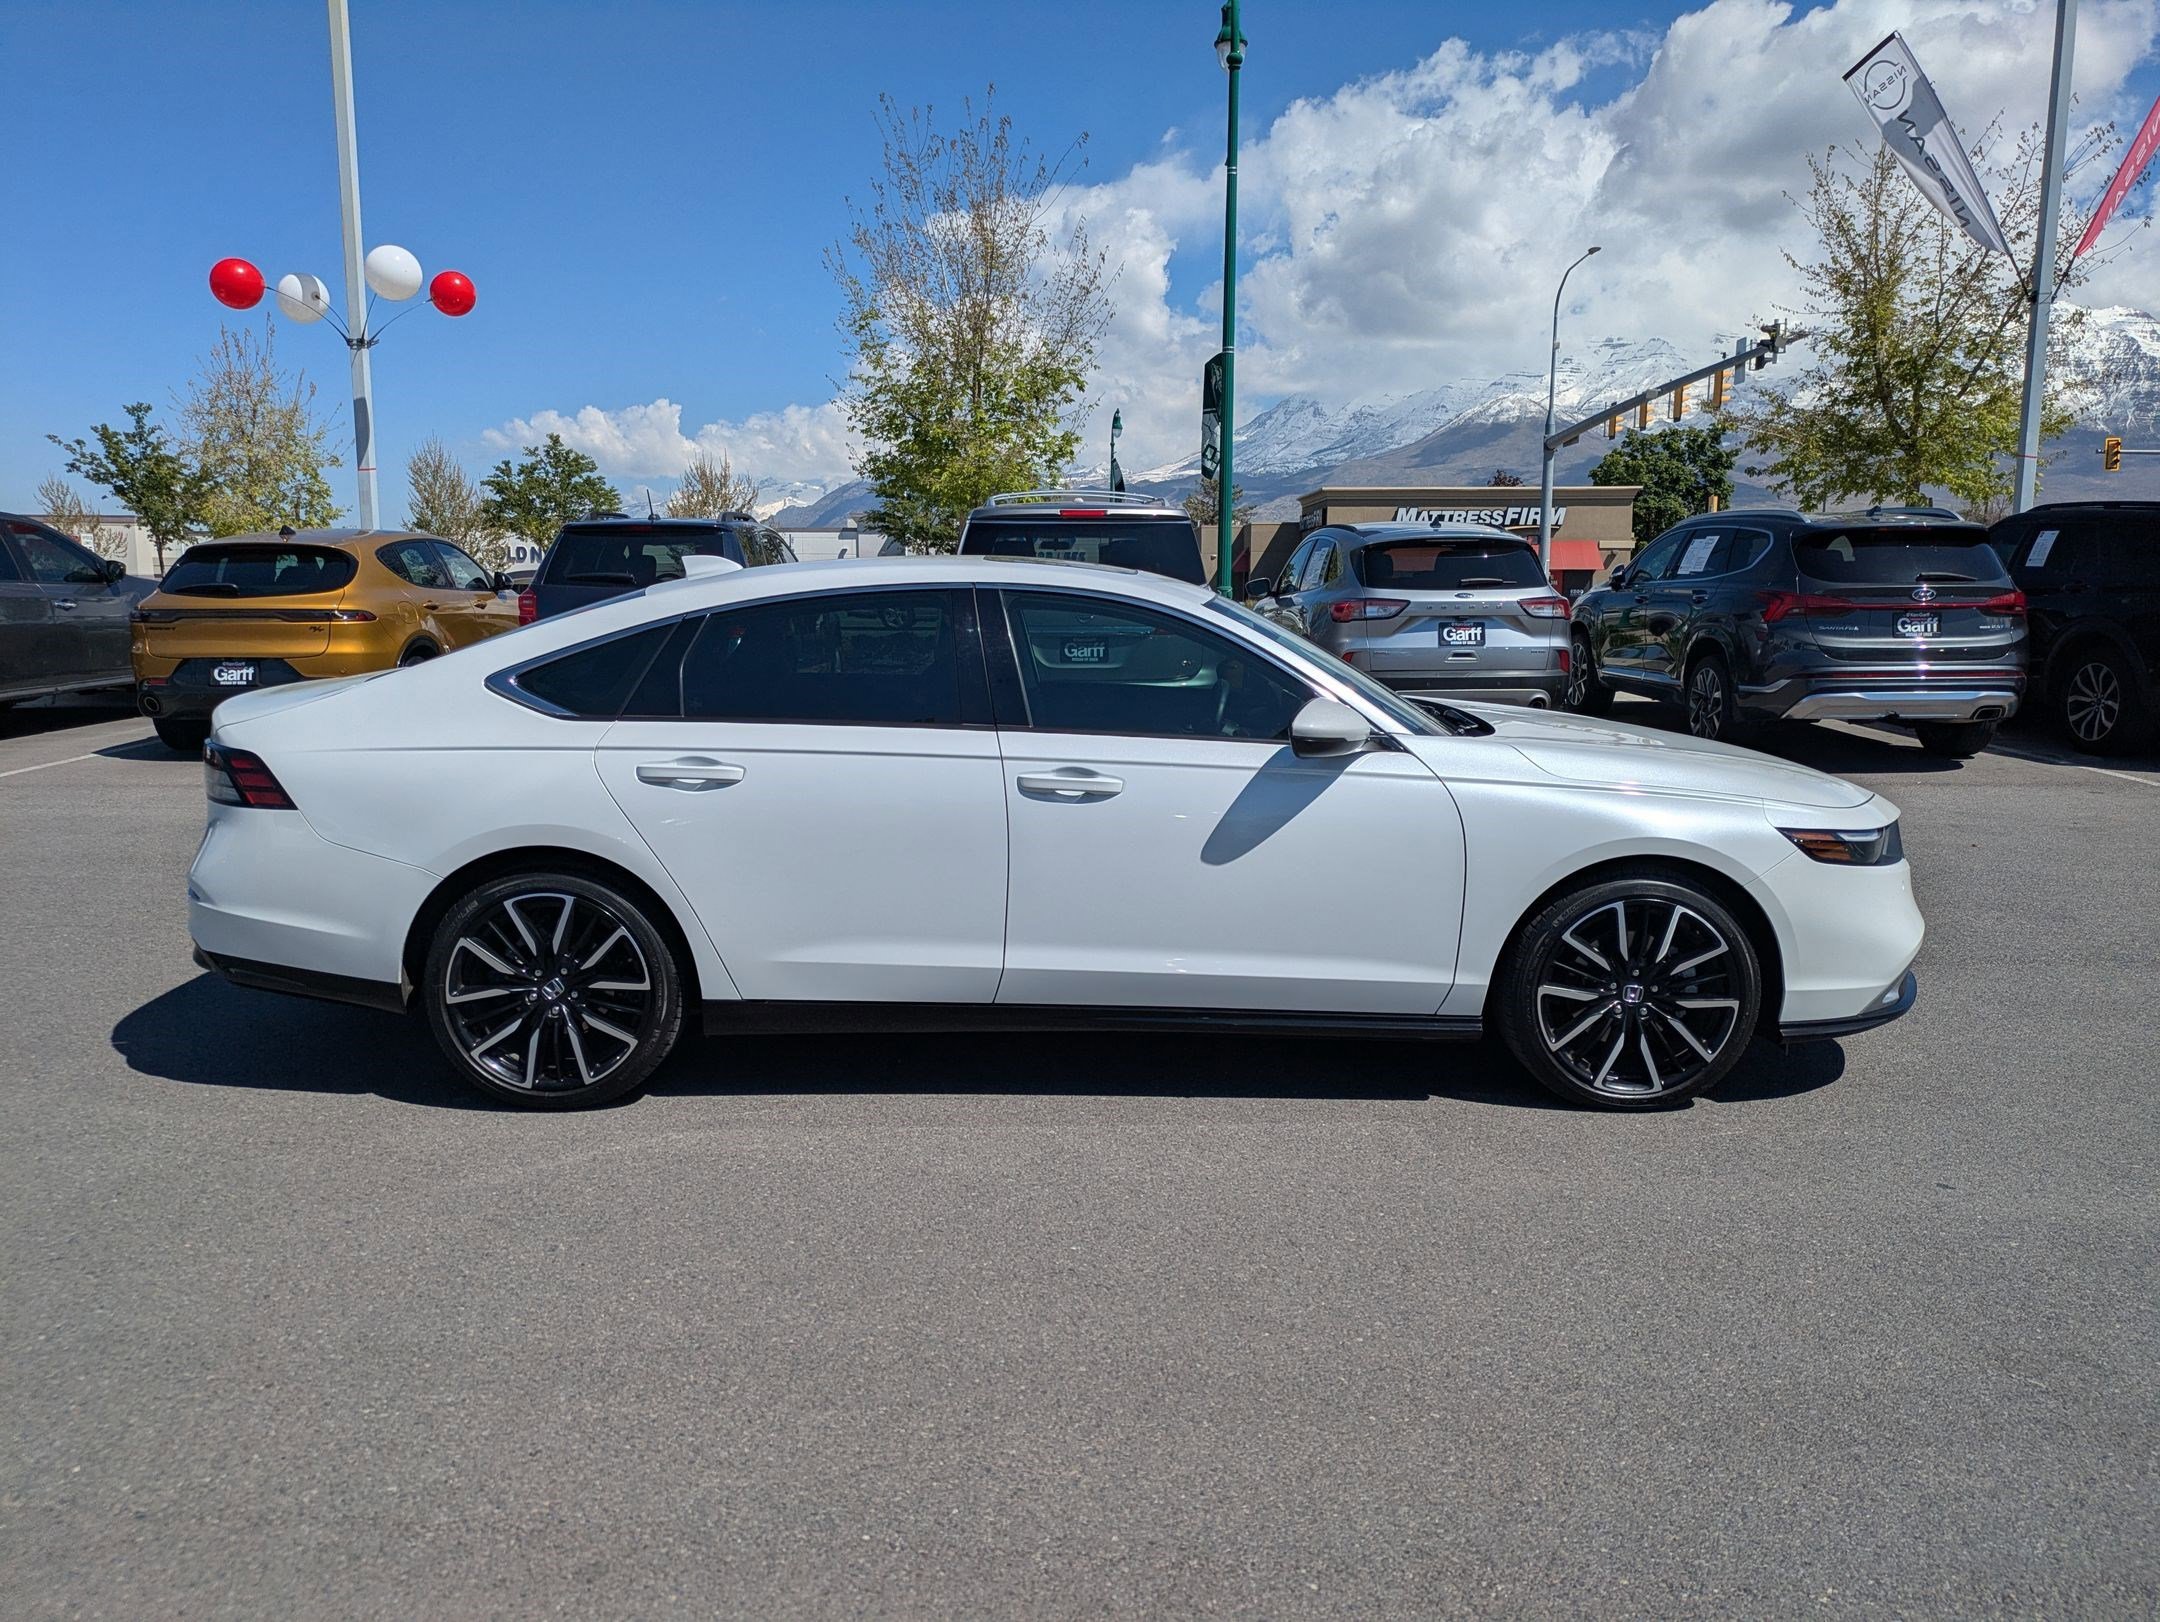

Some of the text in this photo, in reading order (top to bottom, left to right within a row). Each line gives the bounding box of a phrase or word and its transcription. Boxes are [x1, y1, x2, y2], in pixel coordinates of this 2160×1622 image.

[1896, 616, 1939, 633] Garff
[1443, 626, 1483, 641] Garff
[213, 665, 255, 681] Garff
